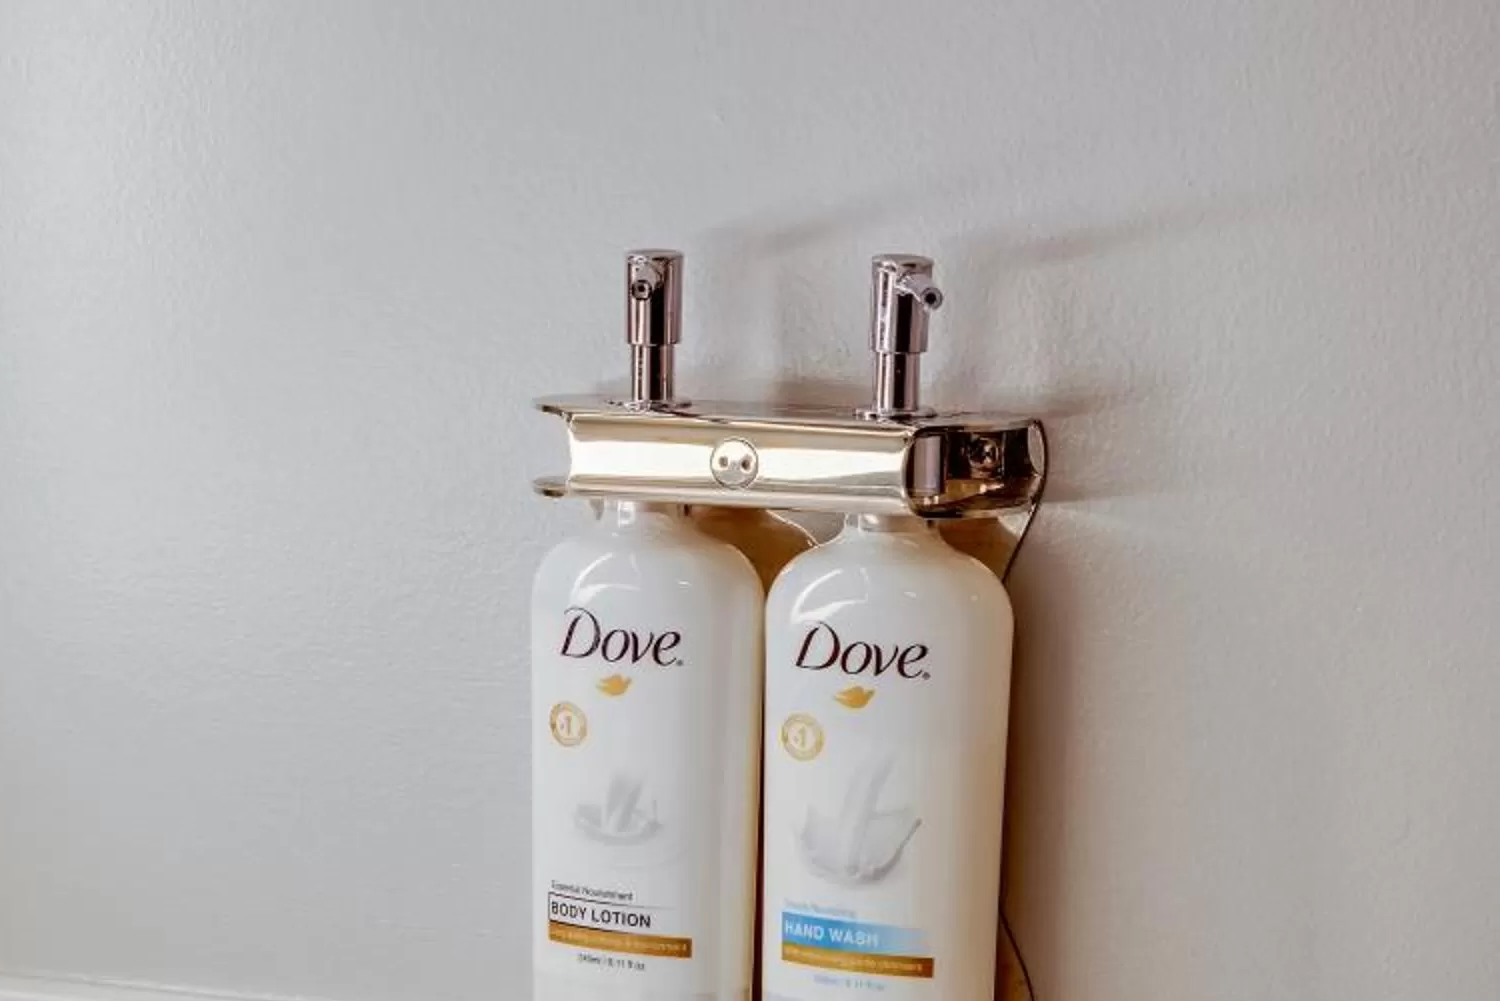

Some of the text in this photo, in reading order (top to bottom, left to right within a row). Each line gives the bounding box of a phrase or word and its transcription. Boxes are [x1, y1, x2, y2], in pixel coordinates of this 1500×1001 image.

[560, 606, 683, 666] Dove
[796, 620, 930, 680] Dove
[551, 901, 651, 928] BODY LOTION
[784, 919, 879, 947] HAND WASH
